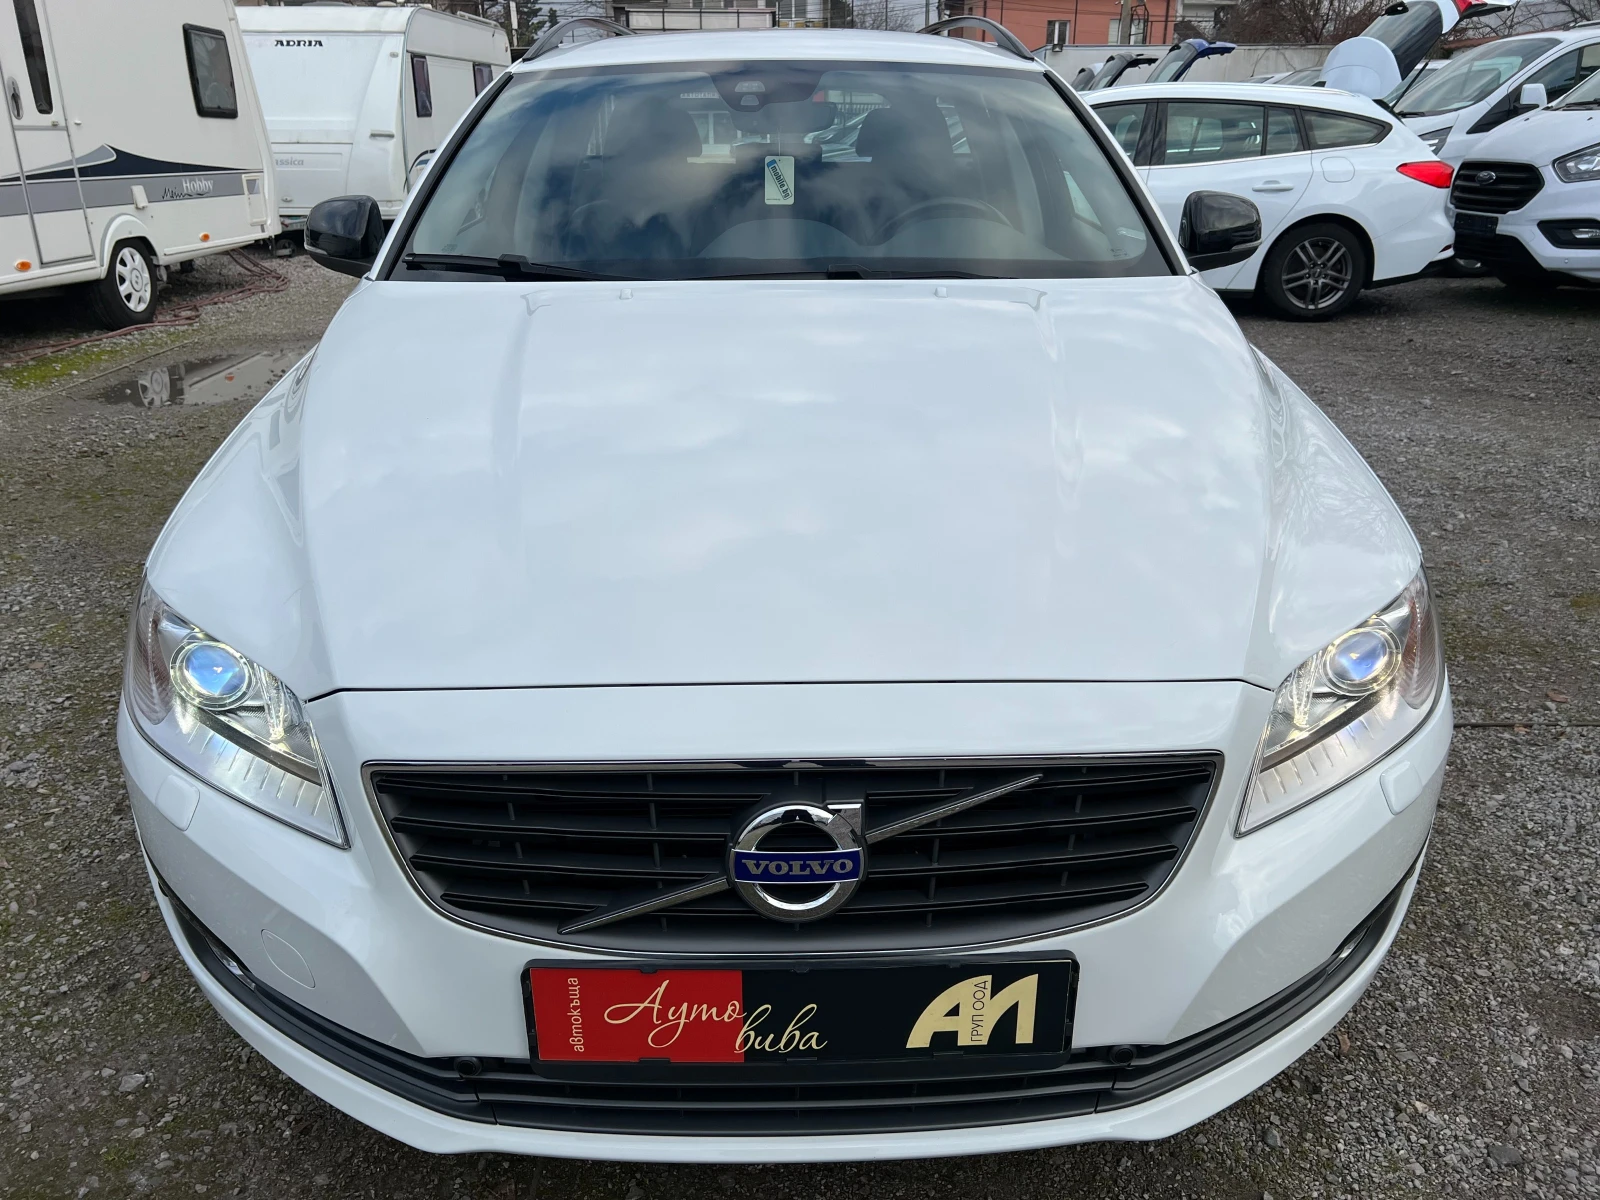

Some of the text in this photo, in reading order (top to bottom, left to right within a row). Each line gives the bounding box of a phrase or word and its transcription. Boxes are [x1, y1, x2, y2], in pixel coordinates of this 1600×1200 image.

[274, 39, 324, 47] ADRIA
[182, 177, 214, 193] Hobby
[770, 165, 790, 198] mobile.bg
[742, 859, 853, 875] VOLVO
[970, 980, 989, 1042] ГРУП ООД
